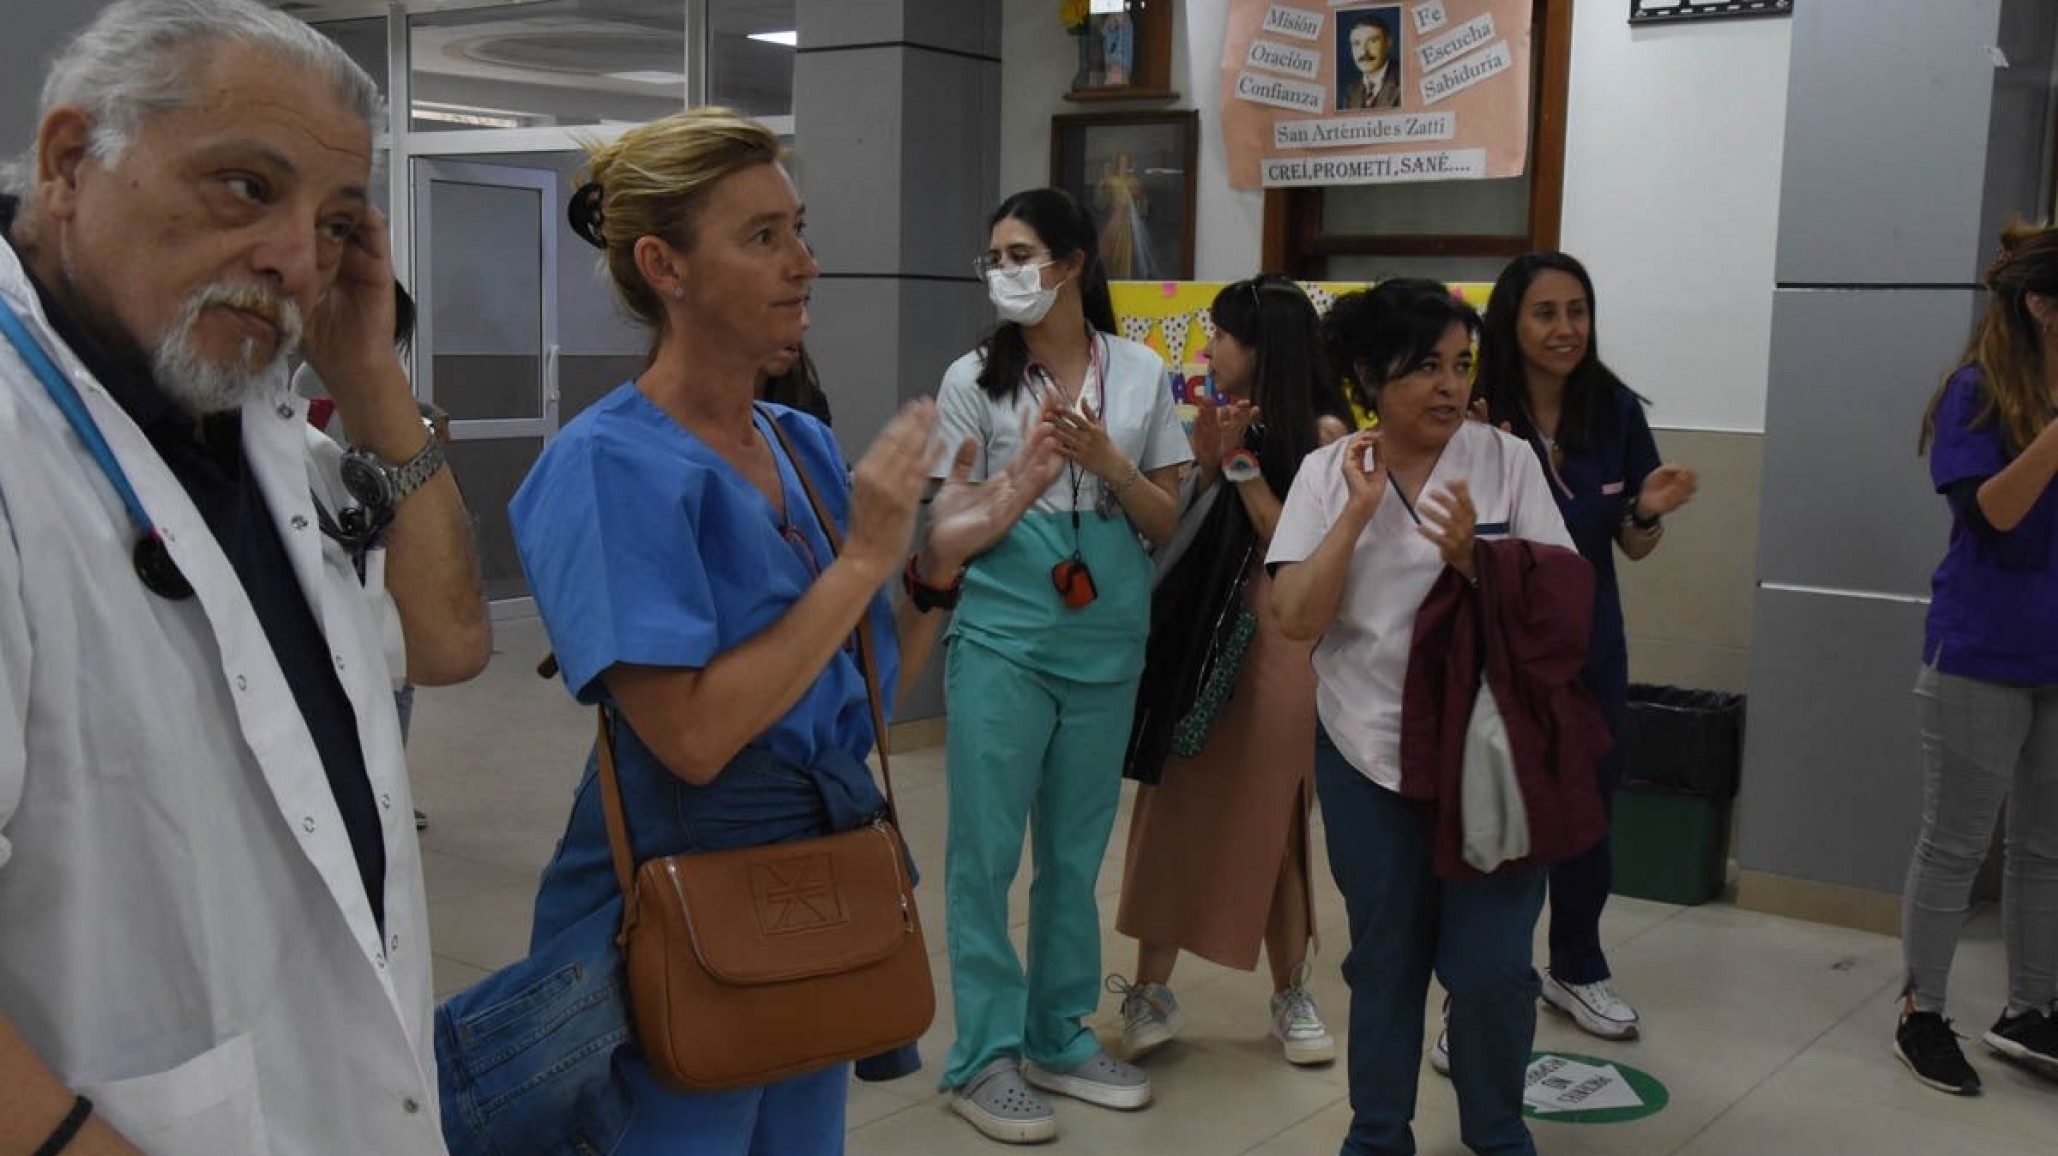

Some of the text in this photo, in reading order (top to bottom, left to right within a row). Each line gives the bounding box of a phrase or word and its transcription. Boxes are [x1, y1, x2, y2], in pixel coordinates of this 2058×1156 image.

[1270, 7, 1318, 35] Misión
[1417, 7, 1442, 27] Fe
[1251, 44, 1313, 71] Oración
[1421, 23, 1492, 66] Escucha
[1239, 76, 1319, 107] Confianza
[1277, 117, 1446, 142] San Artémides Zatti
